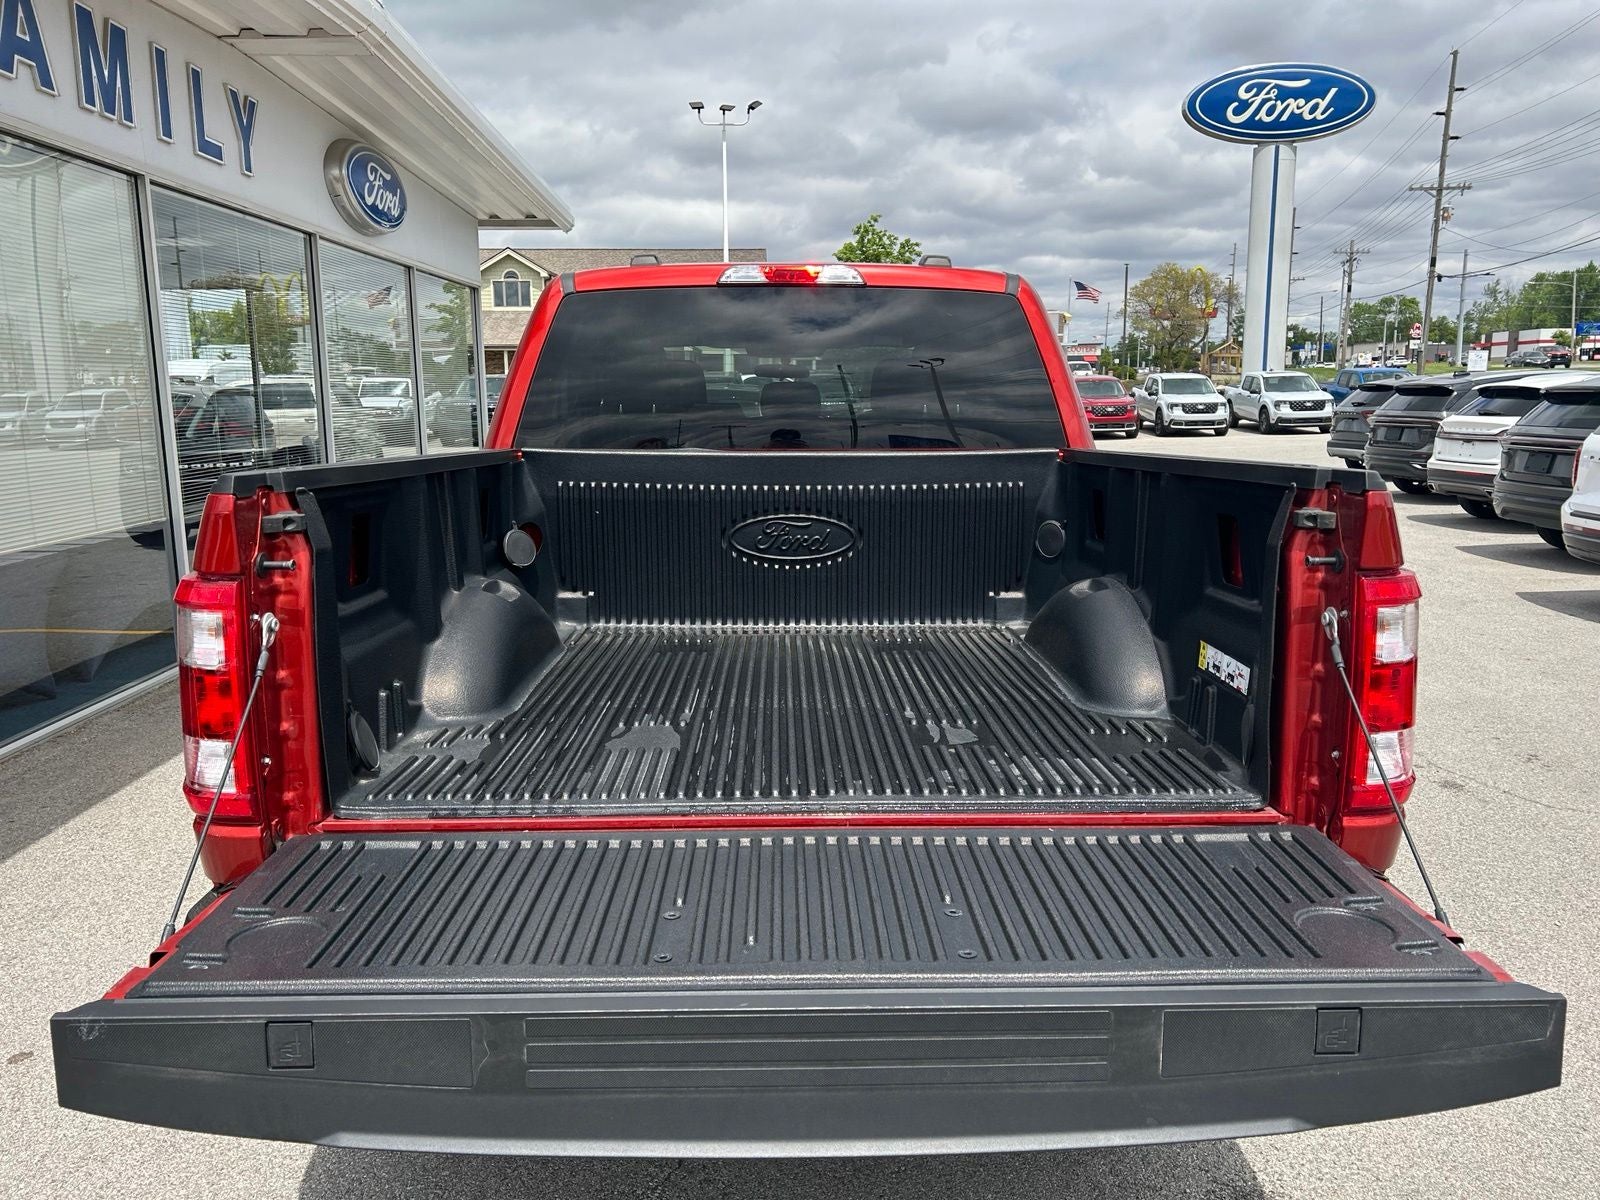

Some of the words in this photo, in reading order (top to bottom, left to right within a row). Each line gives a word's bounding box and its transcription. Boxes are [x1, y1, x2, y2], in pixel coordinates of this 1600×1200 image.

[0, 0, 259, 178] AMILY
[1226, 78, 1339, 124] Ford
[364, 162, 401, 218] Ford
[755, 519, 831, 551] Ford
